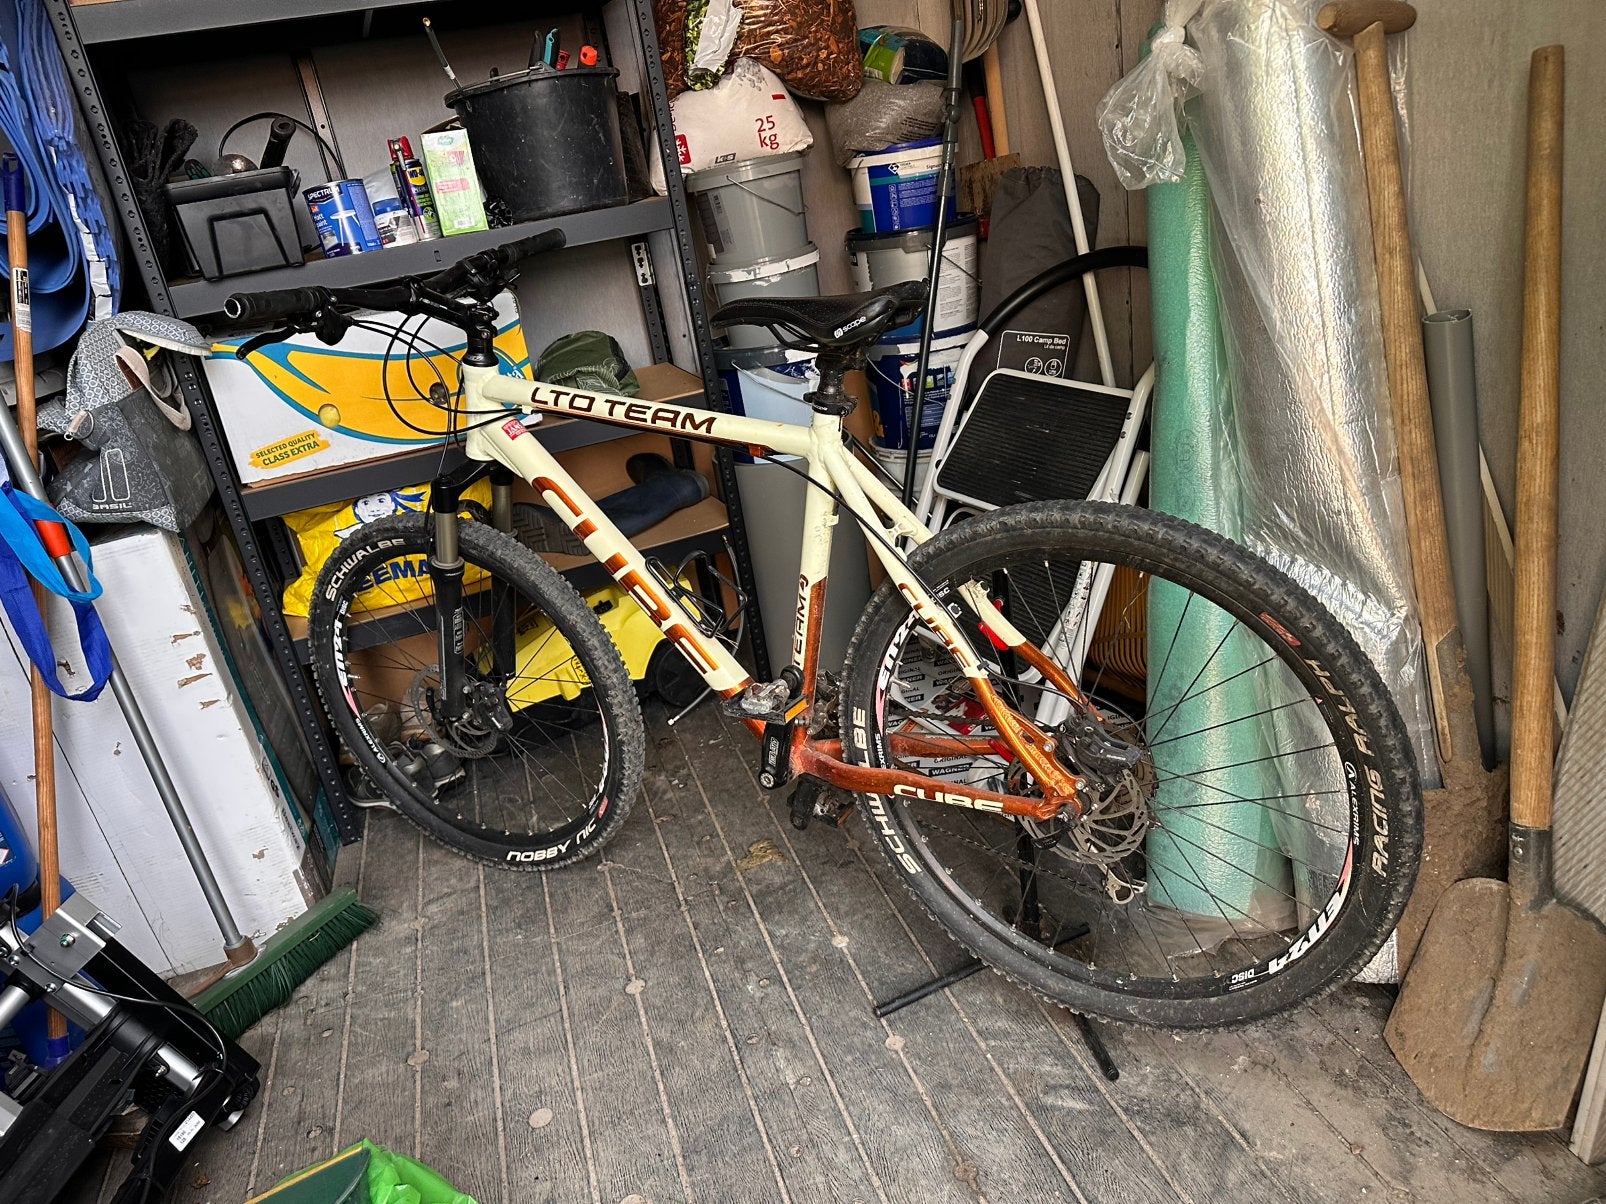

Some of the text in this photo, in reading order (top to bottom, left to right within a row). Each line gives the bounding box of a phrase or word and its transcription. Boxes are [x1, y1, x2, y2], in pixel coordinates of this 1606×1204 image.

[755, 114, 776, 133] 25
[758, 132, 781, 150] kg
[842, 316, 867, 333] scape
[1016, 334, 1067, 345] L100 Camp Bed
[603, 398, 717, 435] TEAM
[255, 432, 316, 459] SELECTED QUALITY
[262, 440, 320, 466] CLASS EXTRA
[325, 538, 407, 602] SCHWALBE
[357, 559, 431, 593] EEMA
[874, 733, 887, 769] EXRIMS
[931, 763, 970, 776] WAGNER
[1303, 658, 1390, 878] RACING RALPH
[852, 706, 923, 875] SCHWLBE
[893, 784, 1004, 813] CUBE
[1349, 780, 1361, 846] ALEXRIMS
[506, 817, 597, 862] NOBBY NIC
[1231, 968, 1255, 984] DISC
